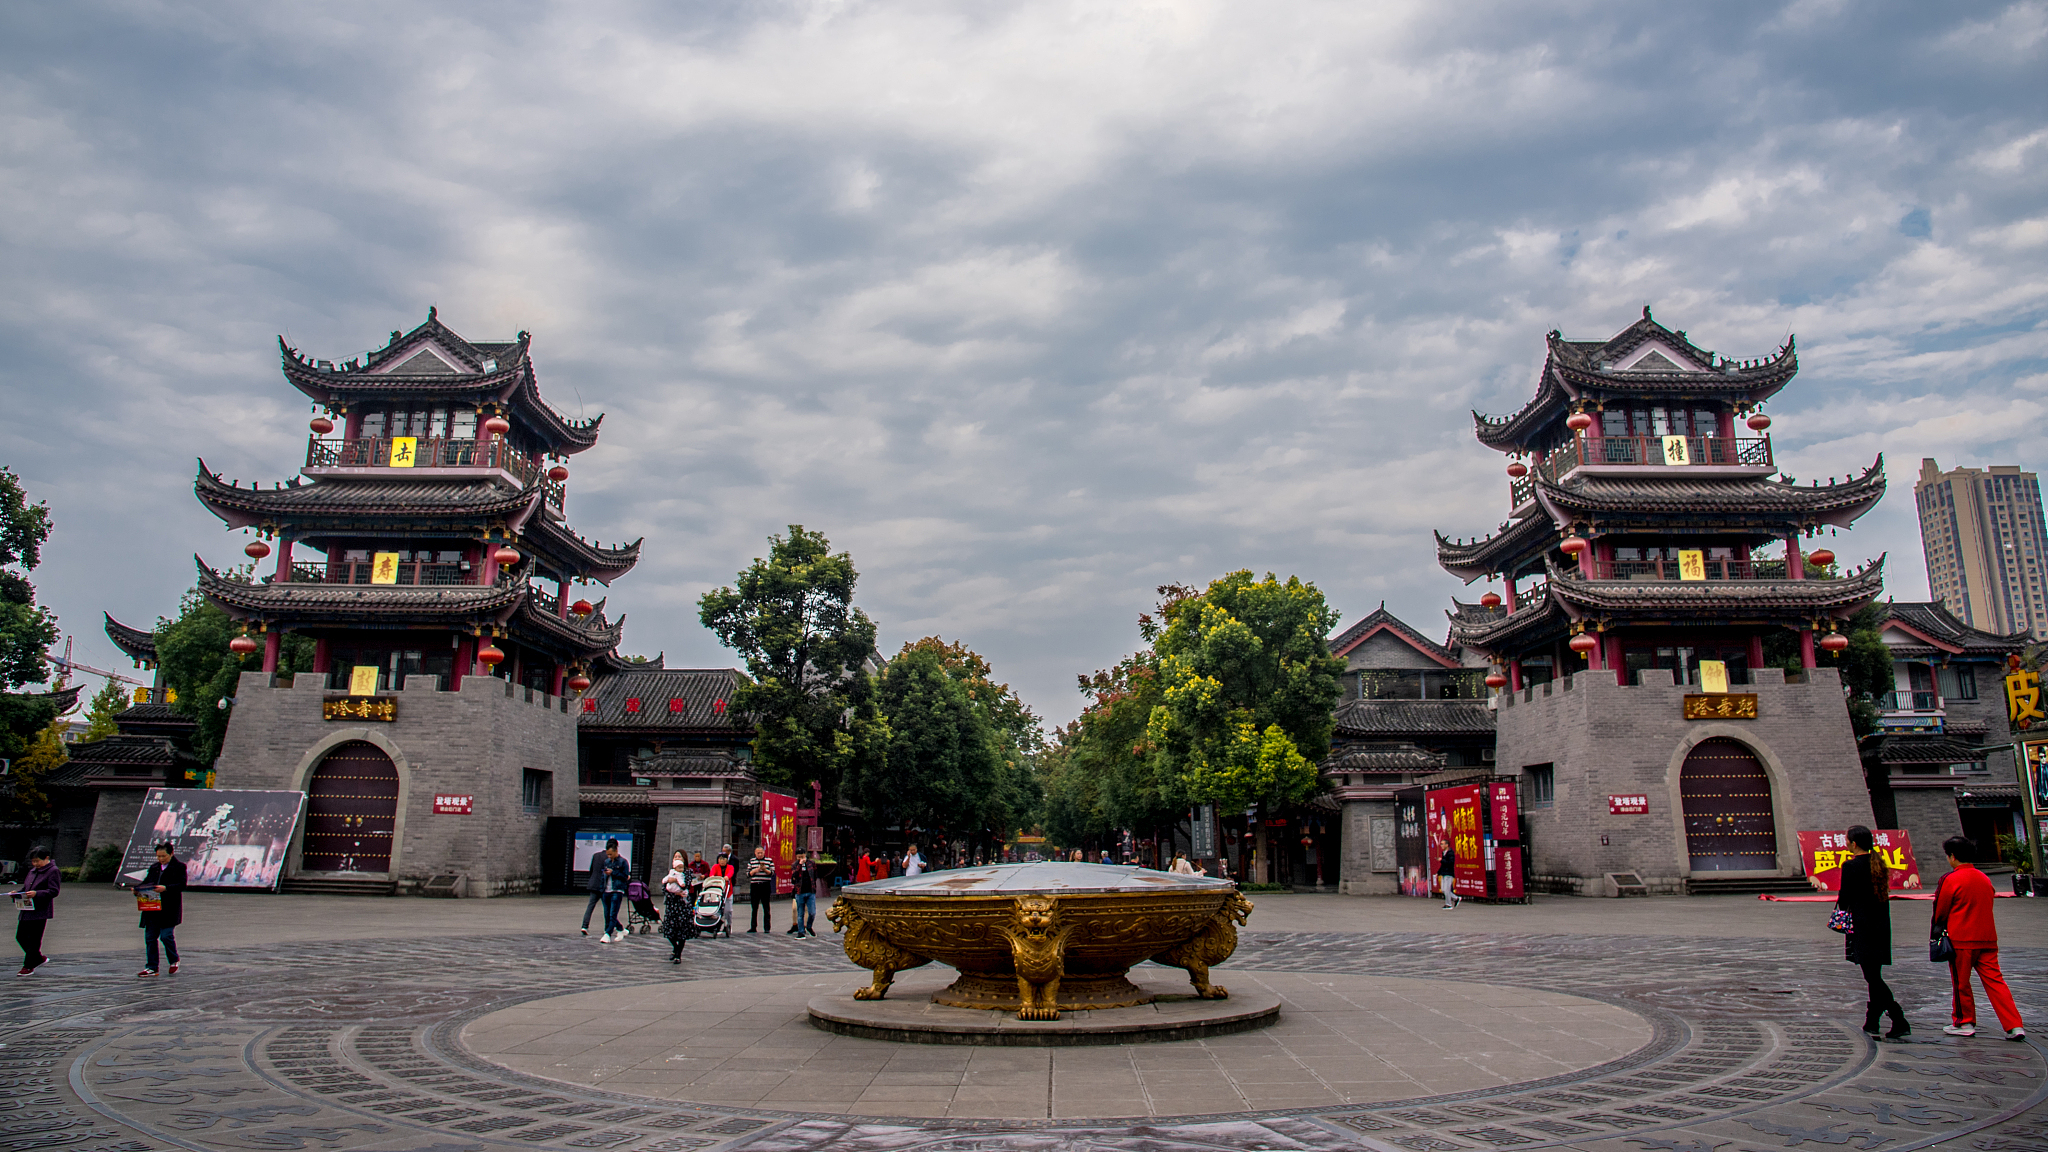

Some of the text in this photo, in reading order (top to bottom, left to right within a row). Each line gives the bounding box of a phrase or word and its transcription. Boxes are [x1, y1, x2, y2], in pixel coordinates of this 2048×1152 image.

[394, 442, 412, 462] 击
[1667, 439, 1685, 462] 撞
[377, 556, 393, 580] 寿
[1683, 553, 1700, 578] 福
[354, 670, 373, 695] 鼓
[2006, 669, 2045, 723] 皮
[1813, 846, 1908, 875] 盛大业
